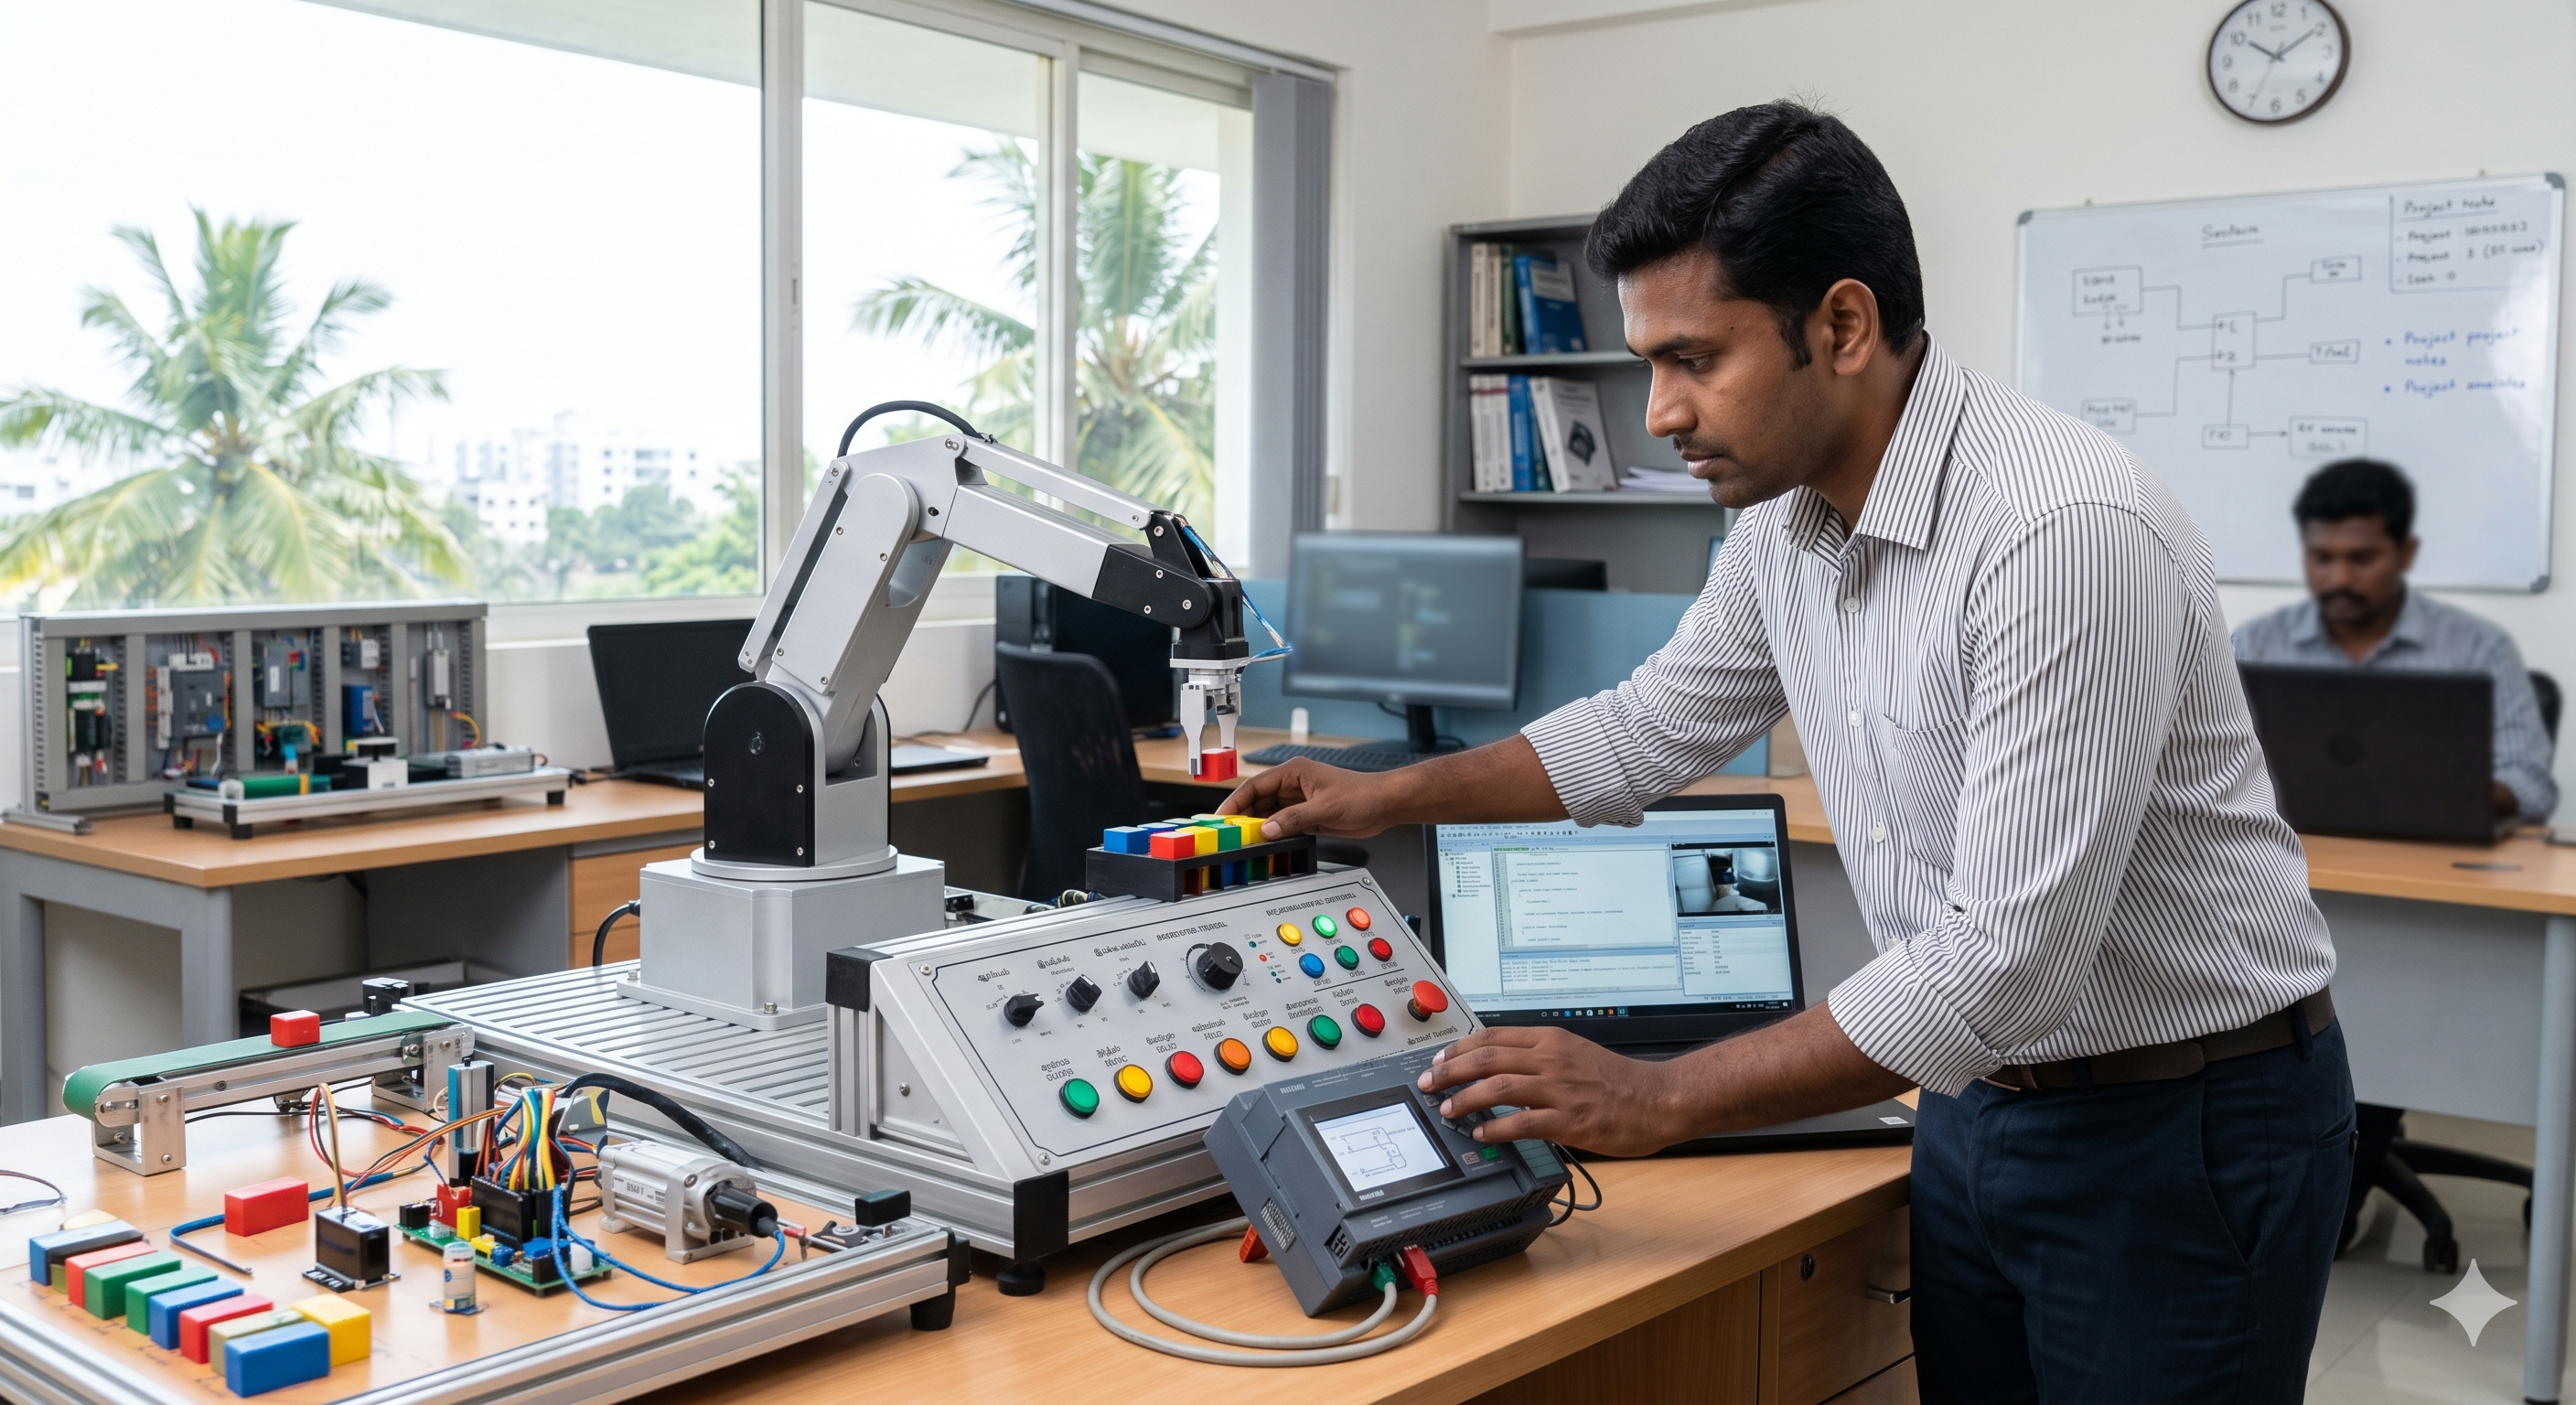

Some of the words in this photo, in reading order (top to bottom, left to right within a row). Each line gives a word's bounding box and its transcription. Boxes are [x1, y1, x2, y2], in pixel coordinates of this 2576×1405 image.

[2270, 3, 2286, 18] 12
[2247, 11, 2261, 27] 11
[2314, 21, 2327, 38] 2
[2230, 30, 2246, 47] 10
[2221, 54, 2233, 71] 9
[2313, 70, 2324, 84] 4
[2295, 88, 2306, 104] 5
[2270, 96, 2281, 114] 6
